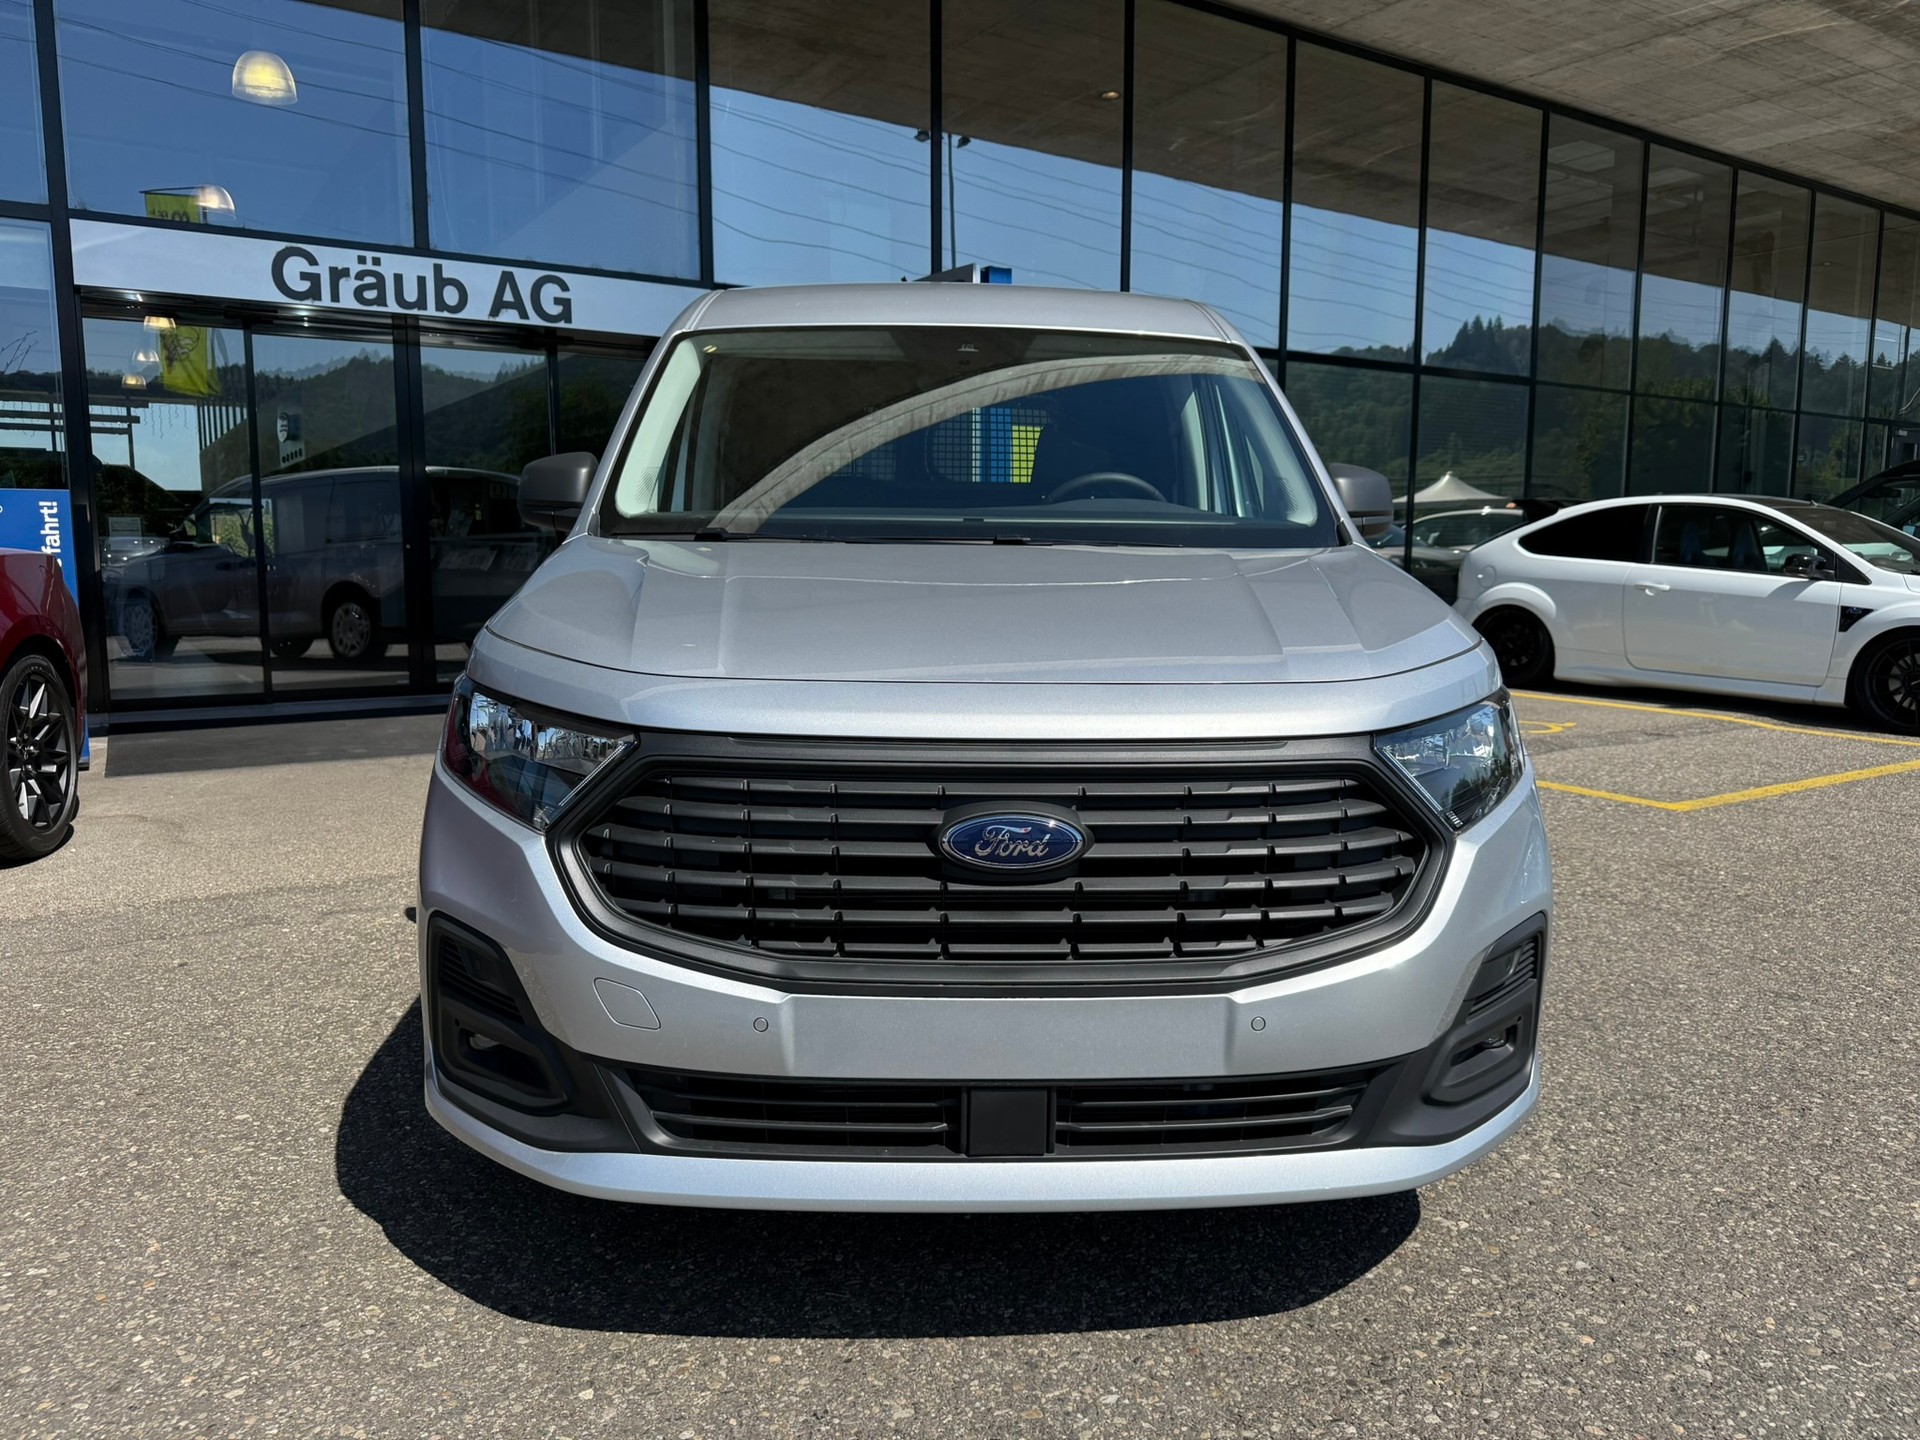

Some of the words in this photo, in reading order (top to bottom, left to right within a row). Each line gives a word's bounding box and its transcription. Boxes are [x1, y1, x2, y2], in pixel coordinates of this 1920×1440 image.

[271, 246, 468, 314] Gräub
[489, 270, 573, 324] AG
[39, 501, 62, 567] fahrt!
[974, 825, 1051, 857] Ford
